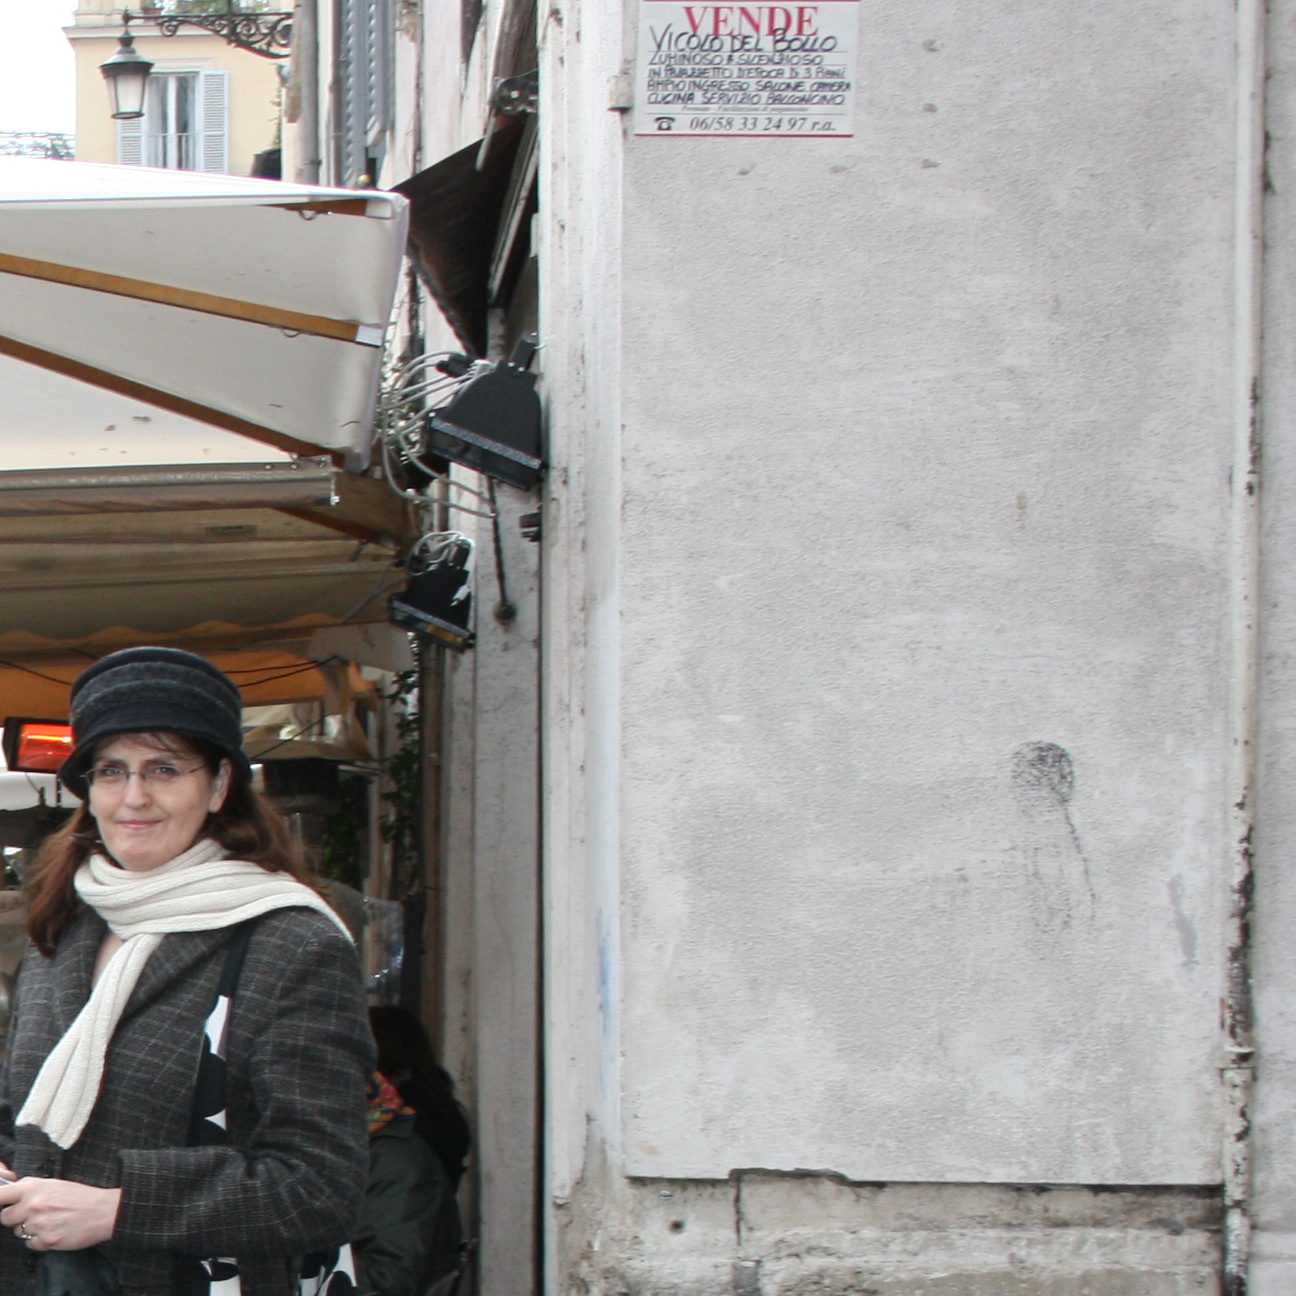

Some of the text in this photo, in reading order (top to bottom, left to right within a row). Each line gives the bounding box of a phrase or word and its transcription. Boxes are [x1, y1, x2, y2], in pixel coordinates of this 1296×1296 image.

[682, 6, 819, 37] VENDE
[649, 22, 724, 52] VICOLO
[729, 33, 764, 52] DEL
[688, 116, 735, 131] 06/58
[736, 116, 759, 131] 33
[761, 116, 784, 131] 24
[786, 116, 808, 131] 97
